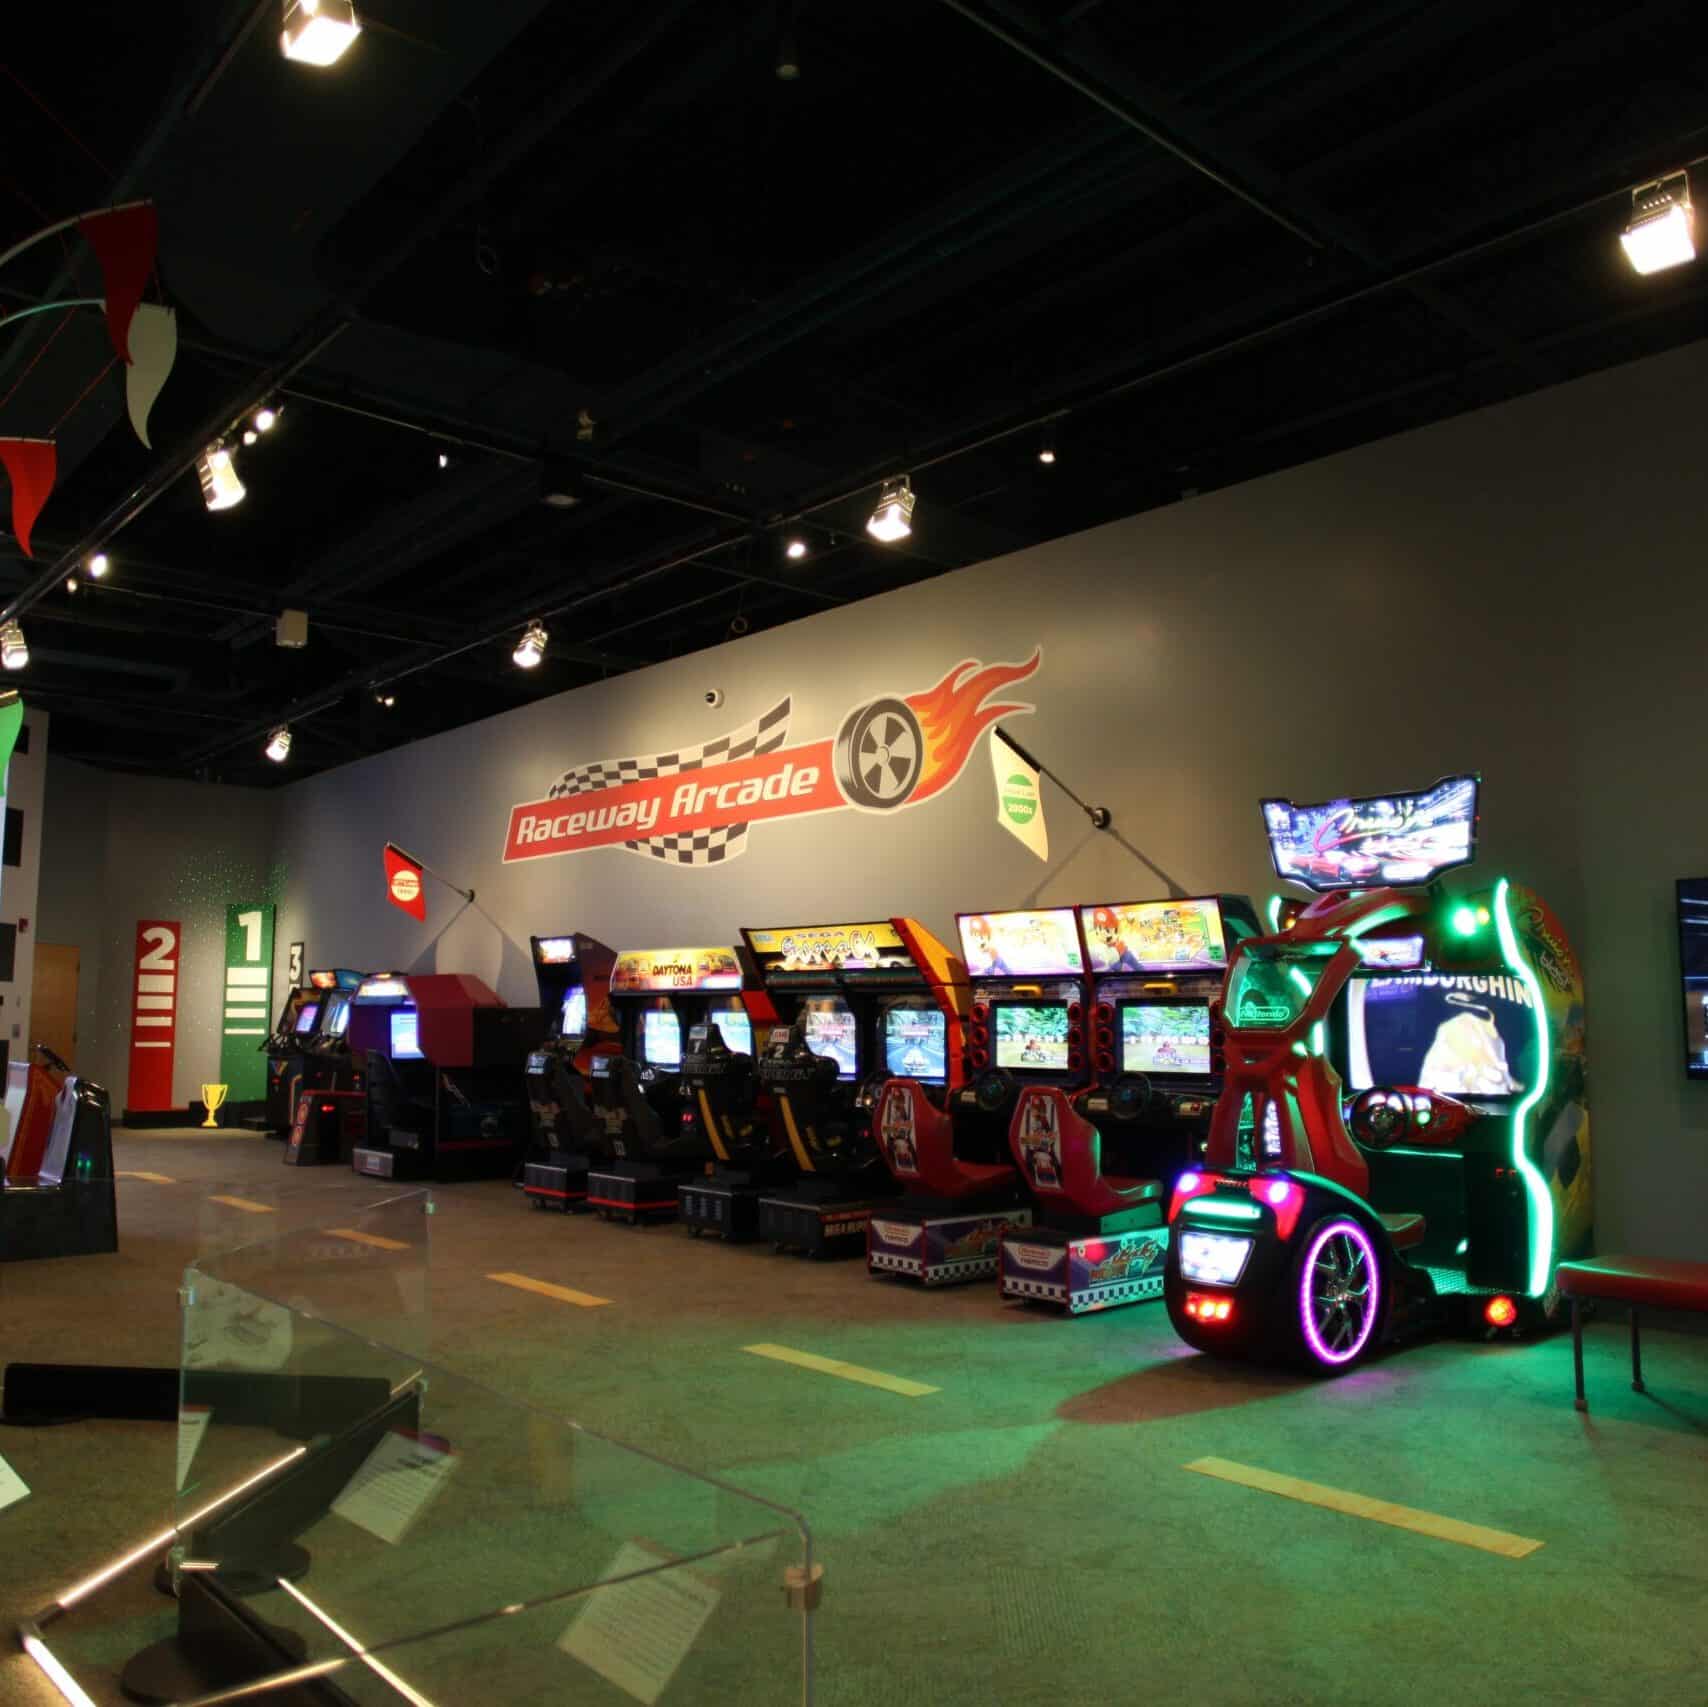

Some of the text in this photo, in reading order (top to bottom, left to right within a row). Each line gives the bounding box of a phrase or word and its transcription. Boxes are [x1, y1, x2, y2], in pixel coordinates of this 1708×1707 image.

[516, 762, 820, 845] Raceway Arcade
[139, 927, 176, 970] 2
[238, 911, 262, 961] 1
[289, 945, 302, 981] 3
[652, 964, 693, 977] DAYTONA
[672, 976, 693, 986] USA
